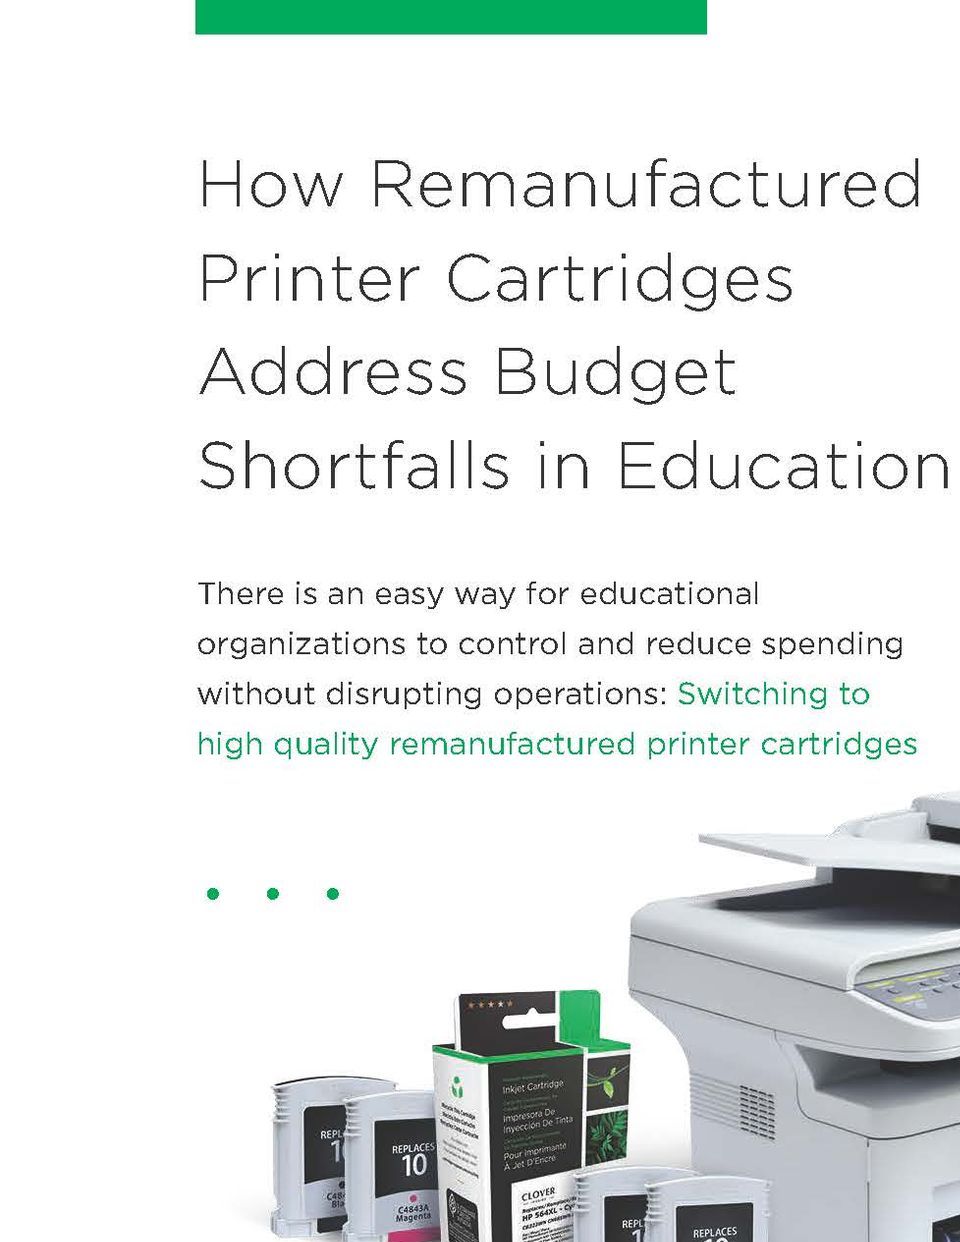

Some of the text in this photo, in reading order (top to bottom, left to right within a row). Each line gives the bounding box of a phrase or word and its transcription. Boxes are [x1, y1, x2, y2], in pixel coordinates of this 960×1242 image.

[202, 157, 919, 209] How Remanufactured
[202, 251, 793, 313] Printer Cartridges
[198, 345, 736, 406] Address Budget
[199, 439, 949, 490] Shortfalls in Education
[197, 580, 758, 610] There is an easy way for educational
[197, 631, 903, 660] organizations to control and reduce spending
[196, 681, 870, 710] without disrupting operations: Switching to
[198, 731, 918, 761] high quality remanufactured printer cartridges
[502, 1079, 564, 1095] Inkjet Cartridge
[503, 1108, 556, 1123] Impresora De
[542, 1119, 554, 1127] De
[555, 1116, 574, 1125] Tinta
[320, 1129, 345, 1140] REPL
[392, 1142, 436, 1154] REPLACES
[503, 1151, 523, 1161] Pour
[401, 1153, 428, 1177] 10
[326, 1192, 345, 1201] C48
[521, 1186, 556, 1201] CLOVER
[398, 1204, 429, 1214] C4843A
[522, 1213, 533, 1222] HP
[534, 1207, 557, 1219] 564XL
[395, 1213, 432, 1222] Magenta
[622, 1219, 645, 1229] REPL
[693, 1226, 738, 1238] REPLACES
